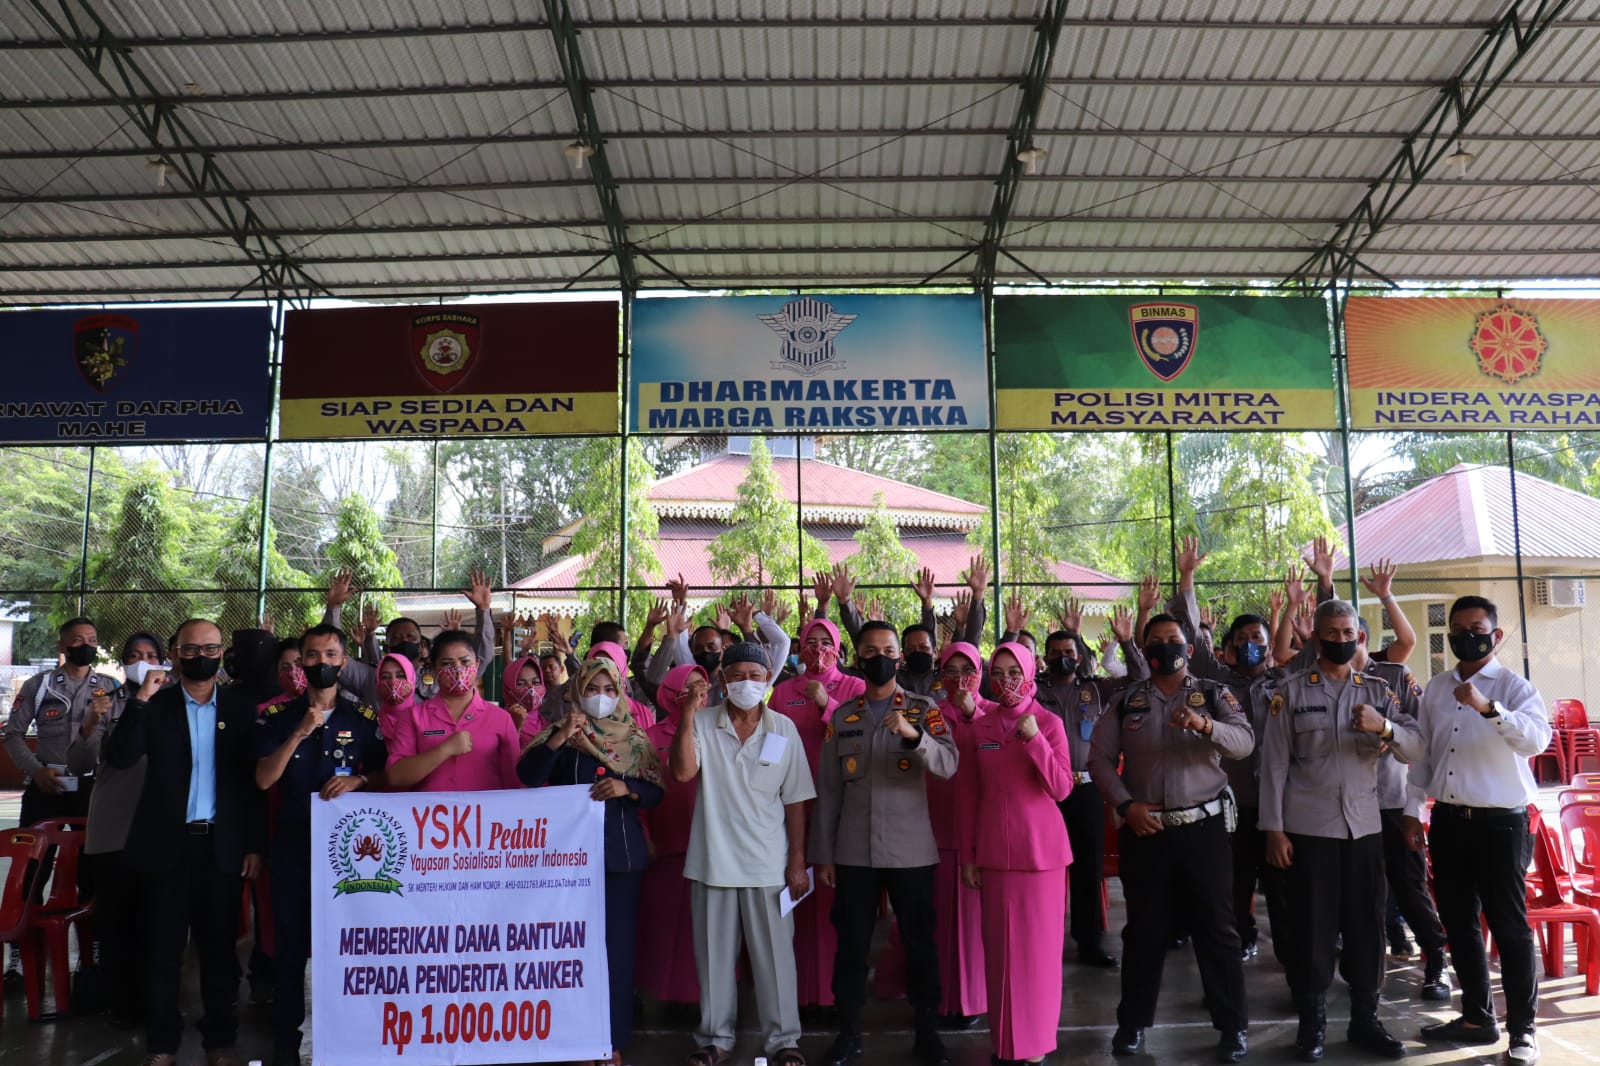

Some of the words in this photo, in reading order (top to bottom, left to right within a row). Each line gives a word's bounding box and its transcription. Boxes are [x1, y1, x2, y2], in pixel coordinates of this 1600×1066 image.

[1141, 307, 1186, 318] BINMAS
[660, 379, 956, 403] DHARMAKERTA
[1054, 392, 1164, 407] POLISI
[1174, 392, 1280, 407] MITRA
[1377, 392, 1491, 406] INDERA
[116, 400, 243, 417] DARPHA
[320, 401, 392, 417] SIAP
[399, 399, 496, 415] SEDIA
[505, 397, 574, 413] DAN
[648, 406, 774, 429] MARGA
[784, 405, 969, 427] RAKSYAKA
[366, 417, 527, 434] WASPADA
[1050, 410, 1285, 425] MASYARAKAT
[1375, 410, 1501, 424] NEGARA
[1510, 411, 1600, 425] RAHA
[57, 421, 146, 437] MAHE
[335, 808, 402, 831] SOSIALISASI
[412, 804, 481, 850] YSKI
[488, 818, 548, 850] Peduli
[328, 832, 343, 876] YAYASAN
[392, 831, 408, 875] KANKER
[410, 854, 449, 875] Yayasan
[453, 851, 502, 870] Sosialisasi
[506, 849, 538, 869] Kanker
[542, 848, 588, 867] Indonesia
[346, 881, 391, 892] INDONESIA
[416, 882, 437, 892] MENTERI
[439, 881, 457, 891] HUKUM
[458, 881, 469, 891] DAN
[470, 880, 481, 890] HAM
[339, 925, 449, 955] MEMBERIKAN
[455, 924, 500, 953] DANA
[507, 921, 586, 951] BANTUAN
[343, 965, 409, 995] KEPADA
[415, 963, 508, 994] PENDERITA
[515, 959, 583, 990] KANKER
[382, 1001, 412, 1055] Rp
[421, 1000, 551, 1044] 1.000.000
